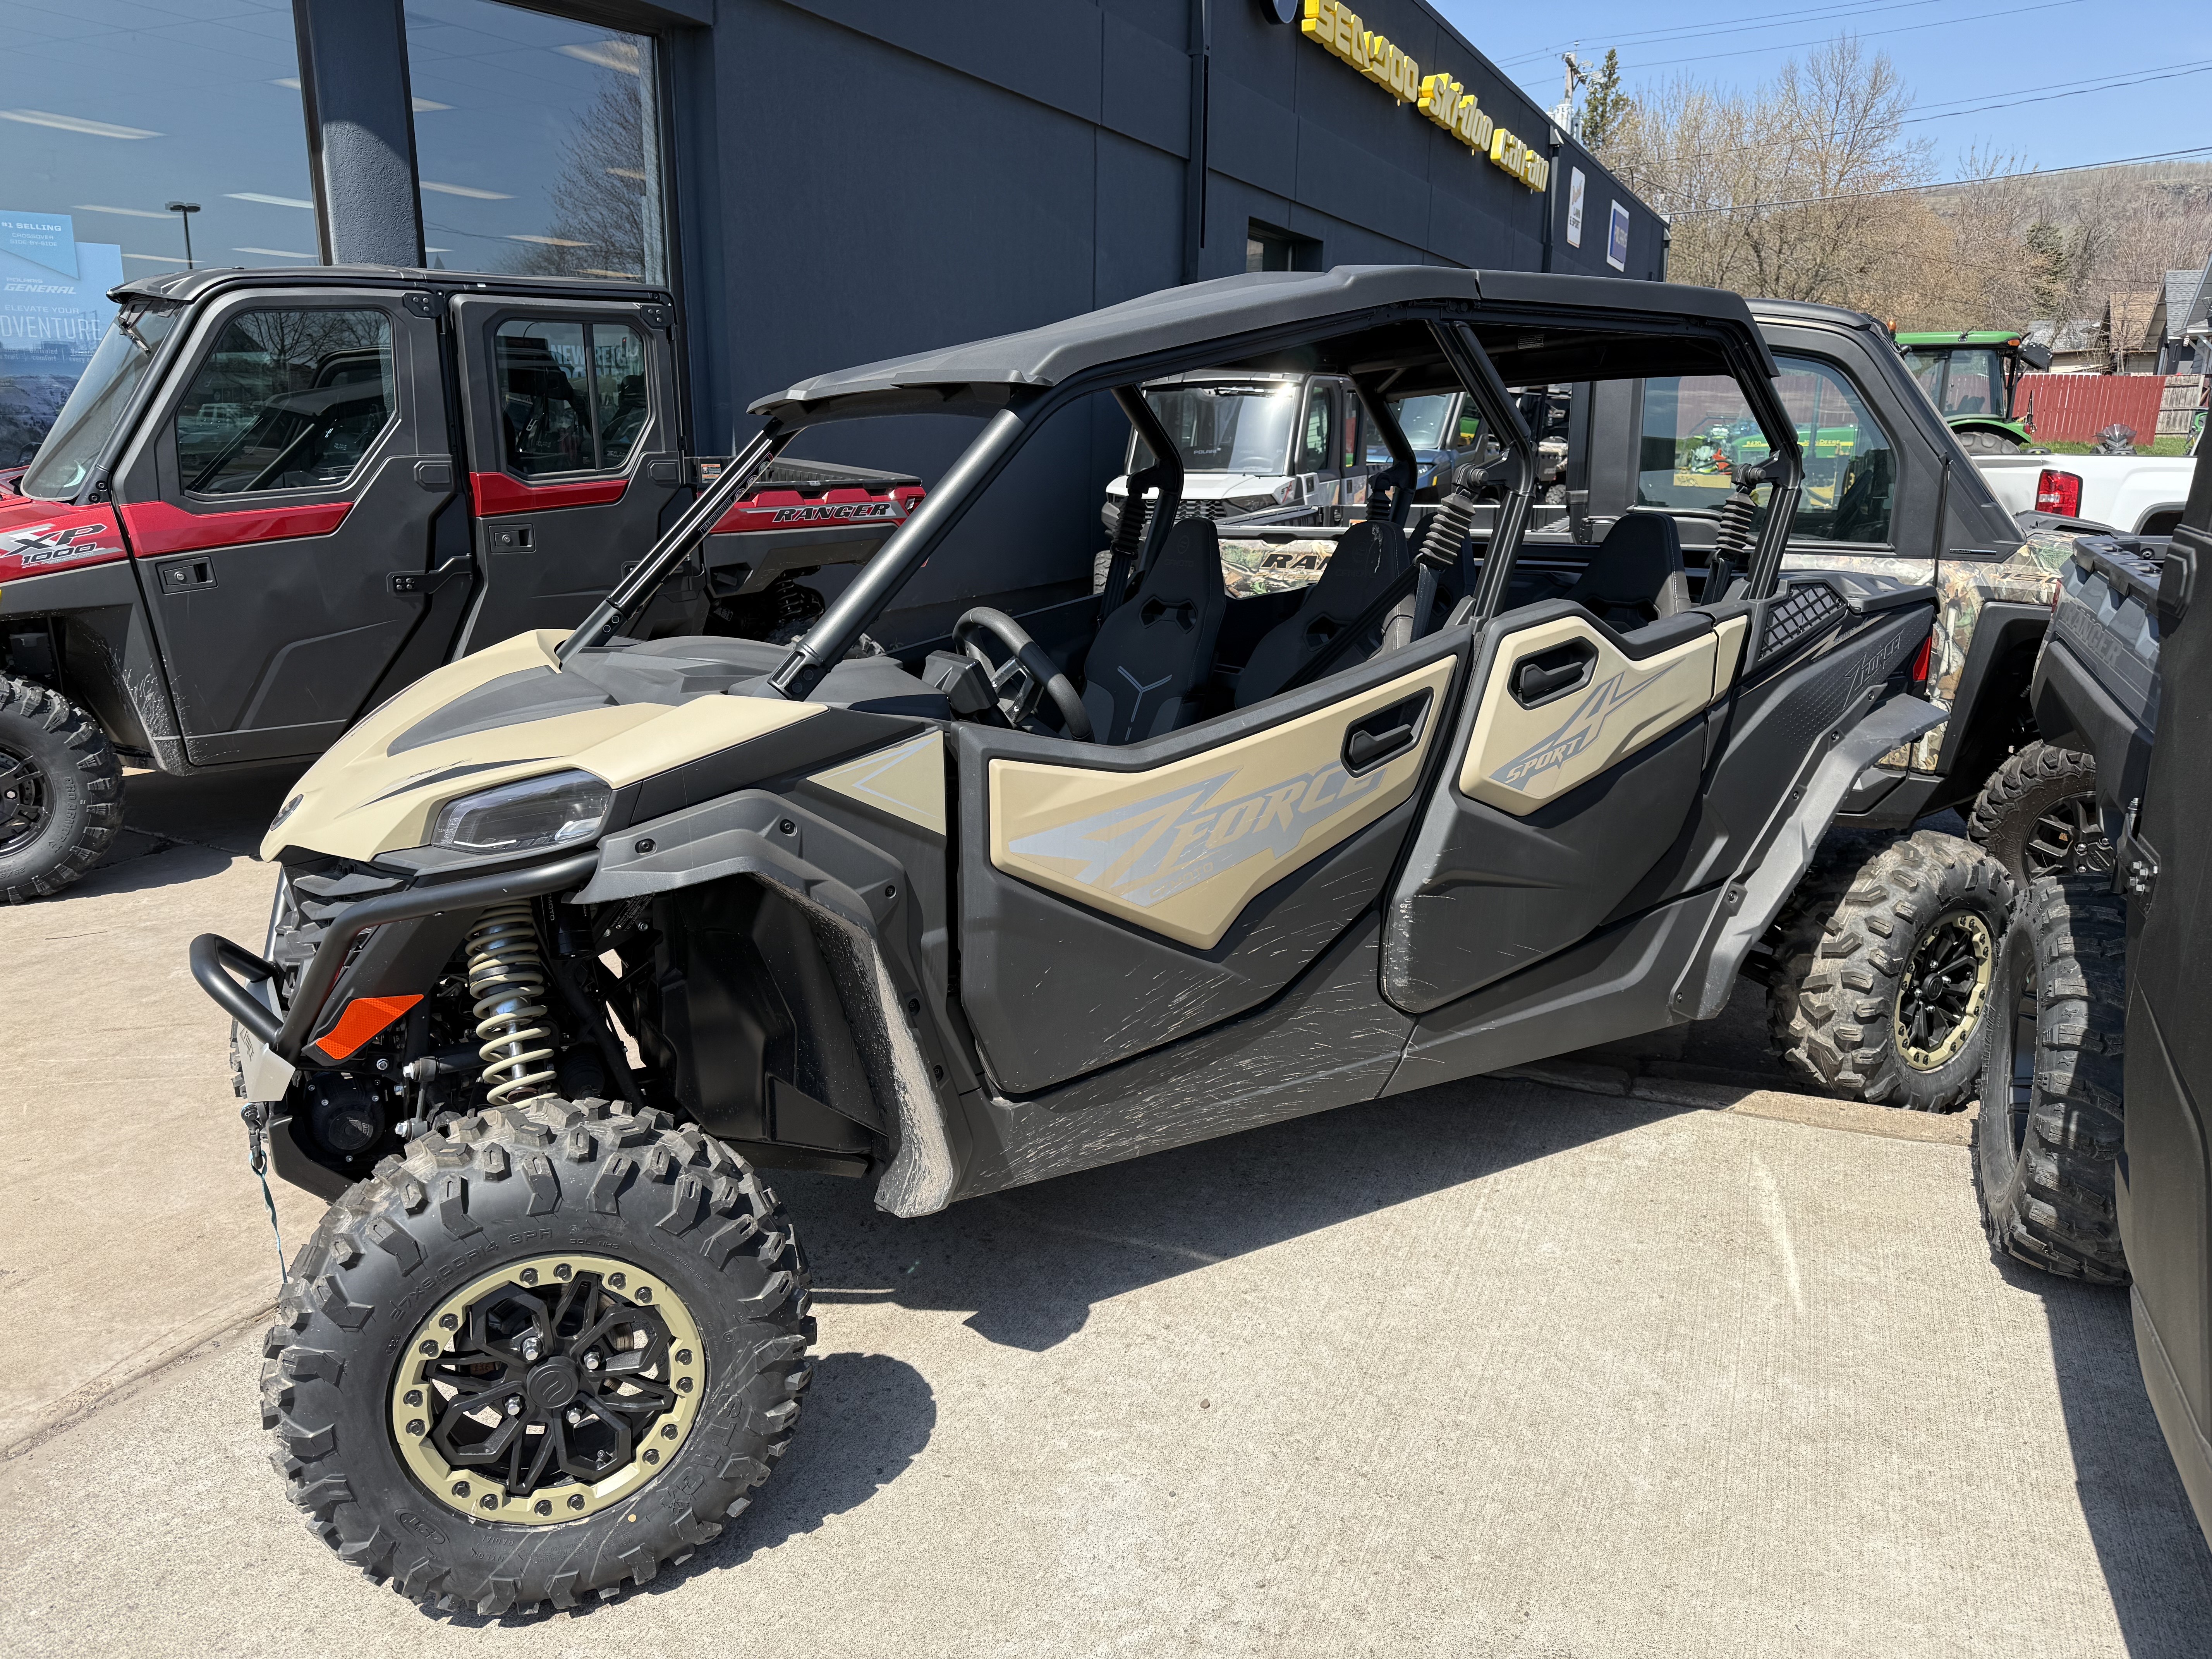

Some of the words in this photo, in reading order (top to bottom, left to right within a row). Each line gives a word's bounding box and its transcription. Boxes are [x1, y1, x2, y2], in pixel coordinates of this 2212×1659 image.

[16, 223, 62, 231] SELLING
[3, 283, 76, 295] GENERAL
[550, 345, 585, 365] NEW
[772, 503, 891, 522] RANGER
[1, 523, 108, 557] XP
[21, 542, 97, 565] 1000
[41, 555, 77, 565] OVERHEAD
[2060, 601, 2123, 668] RANGER
[1504, 737, 1583, 784] SPORT
[63, 776, 76, 800] PRO
[481, 1534, 514, 1546] RADIAL
[471, 1551, 505, 1563] NYLON
